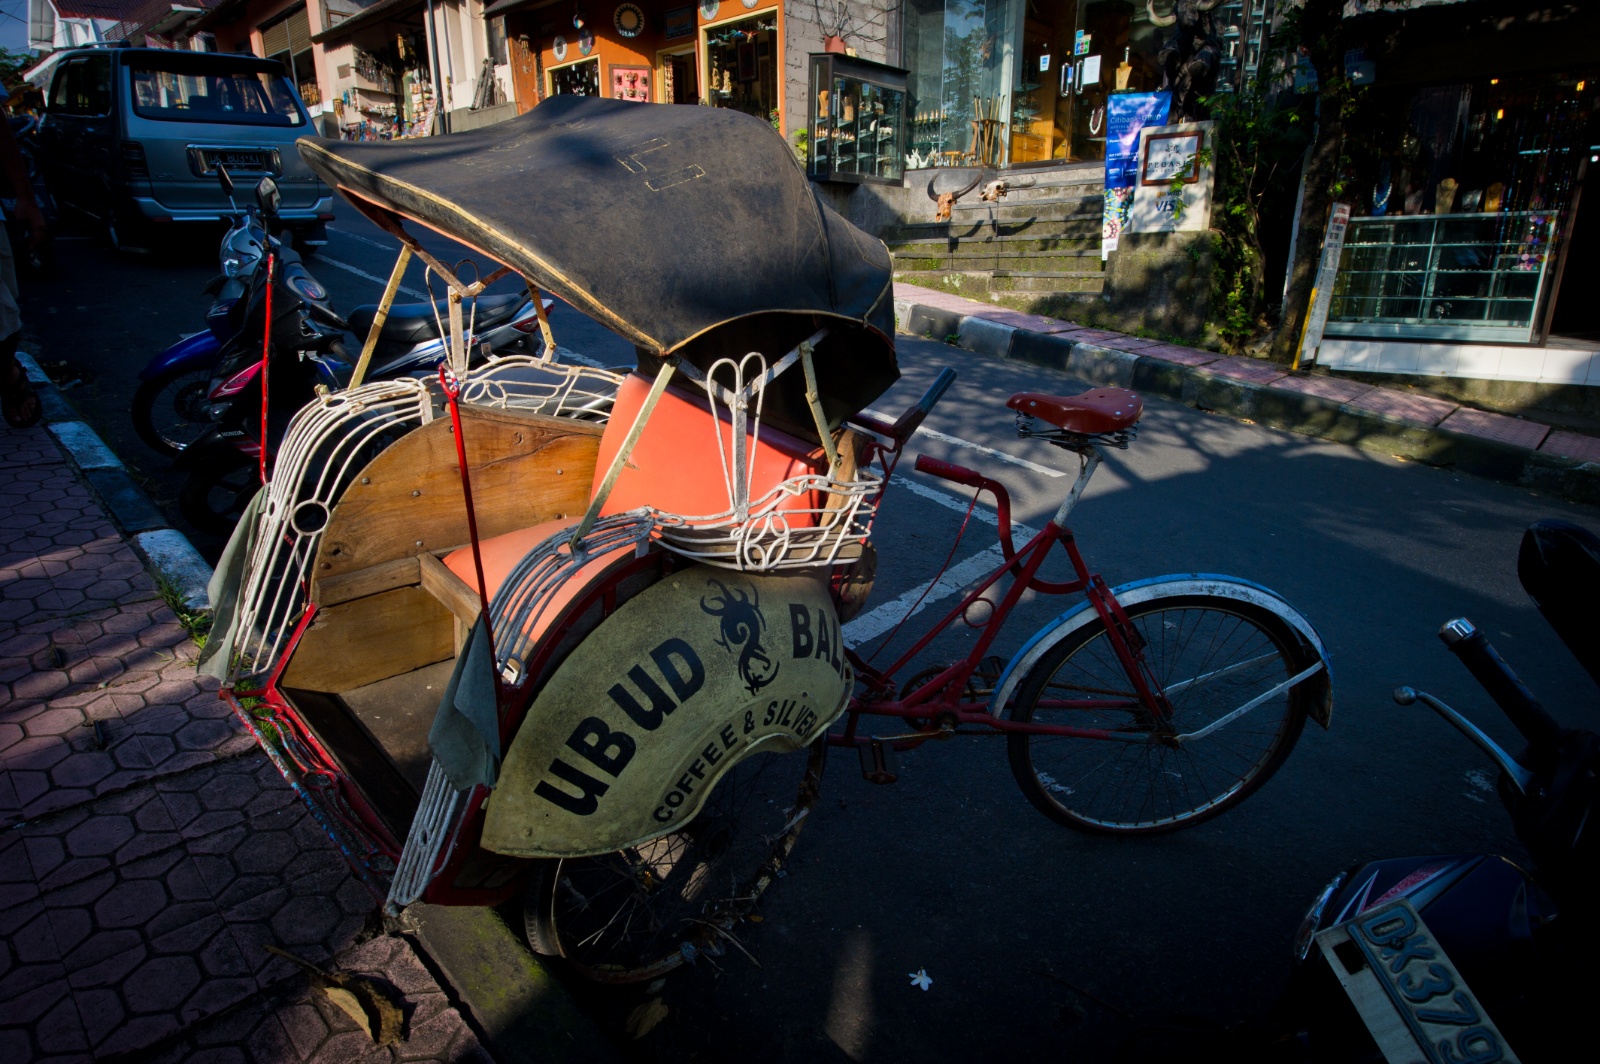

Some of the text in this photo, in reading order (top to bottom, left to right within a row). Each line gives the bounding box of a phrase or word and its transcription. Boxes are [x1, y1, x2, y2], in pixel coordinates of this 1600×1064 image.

[1155, 200, 1182, 212] VIS
[533, 637, 706, 817] UBUD
[652, 699, 818, 823] COFFEE & SILVER
